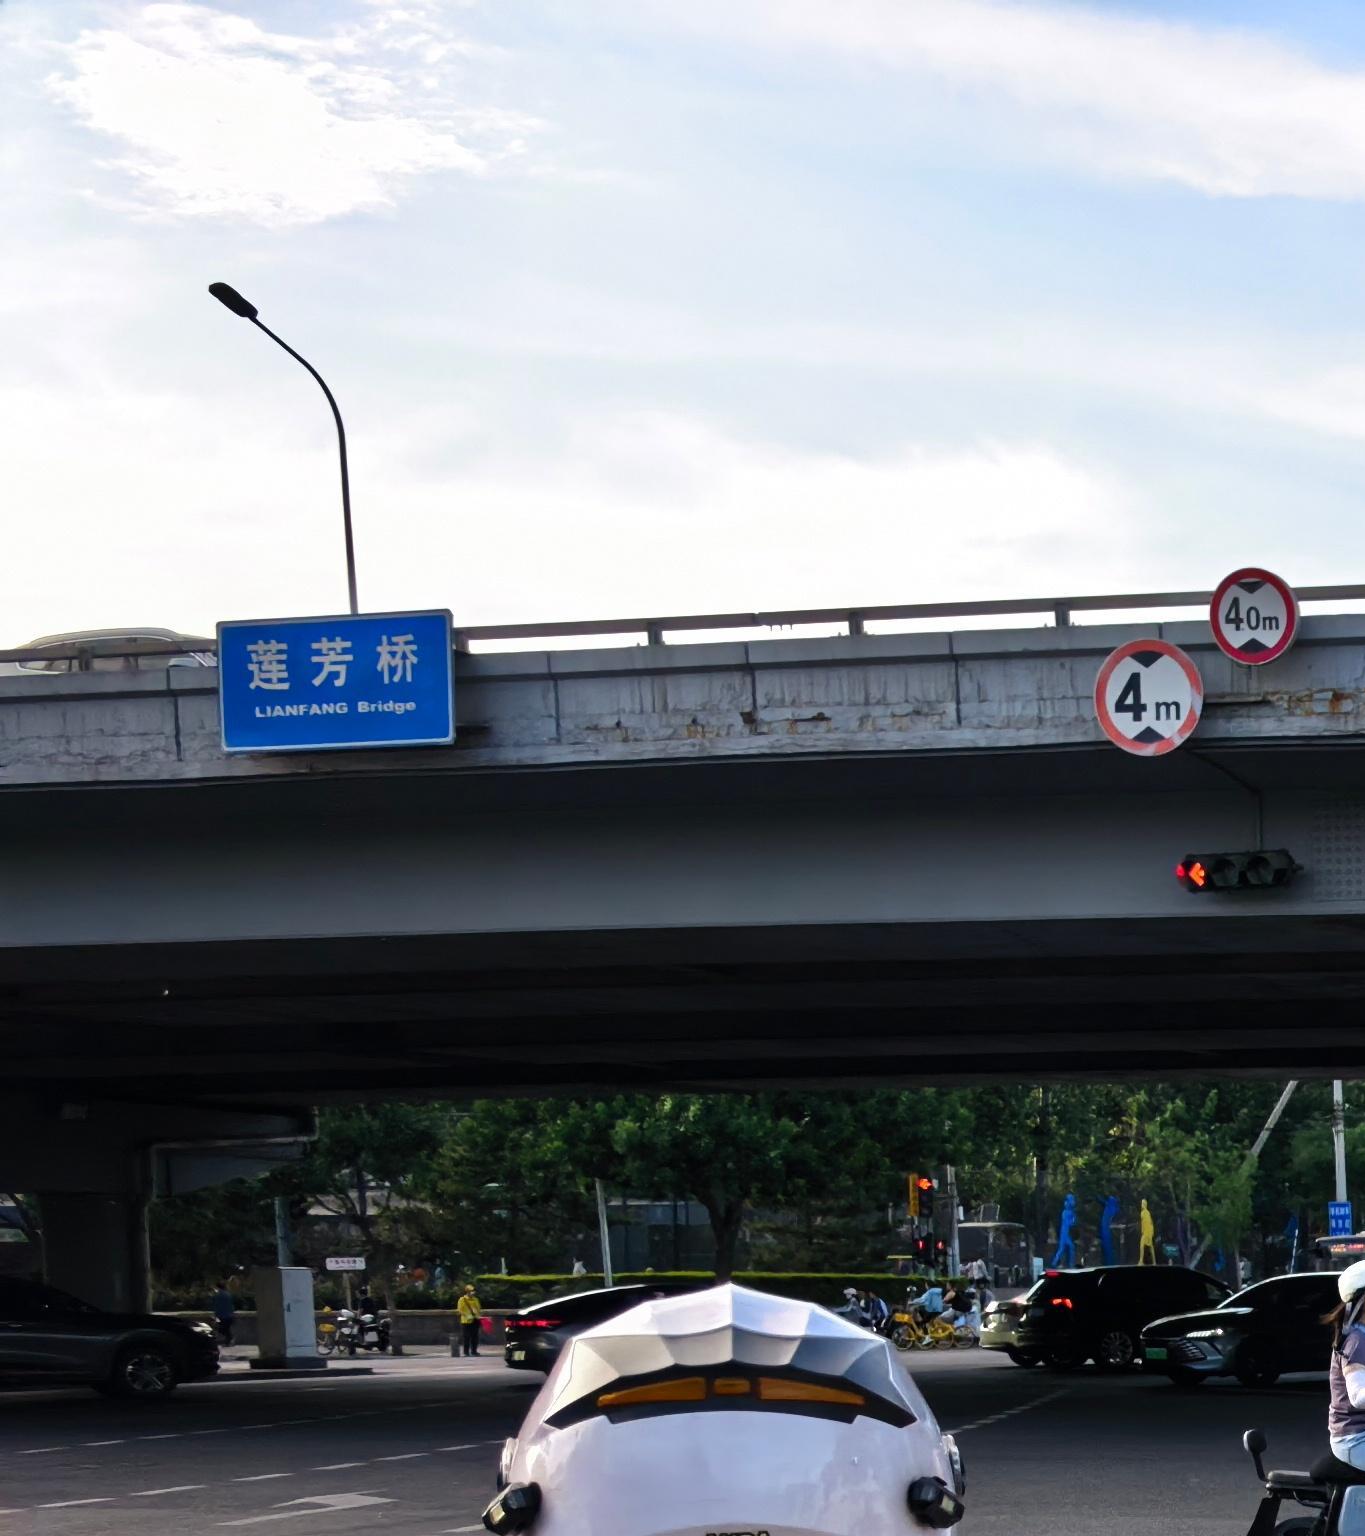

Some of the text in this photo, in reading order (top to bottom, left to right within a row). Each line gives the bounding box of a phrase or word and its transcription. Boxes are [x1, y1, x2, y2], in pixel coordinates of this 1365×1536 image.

[246, 634, 418, 690] 莲芳桥
[255, 700, 417, 718] LIANFANG Bridge
